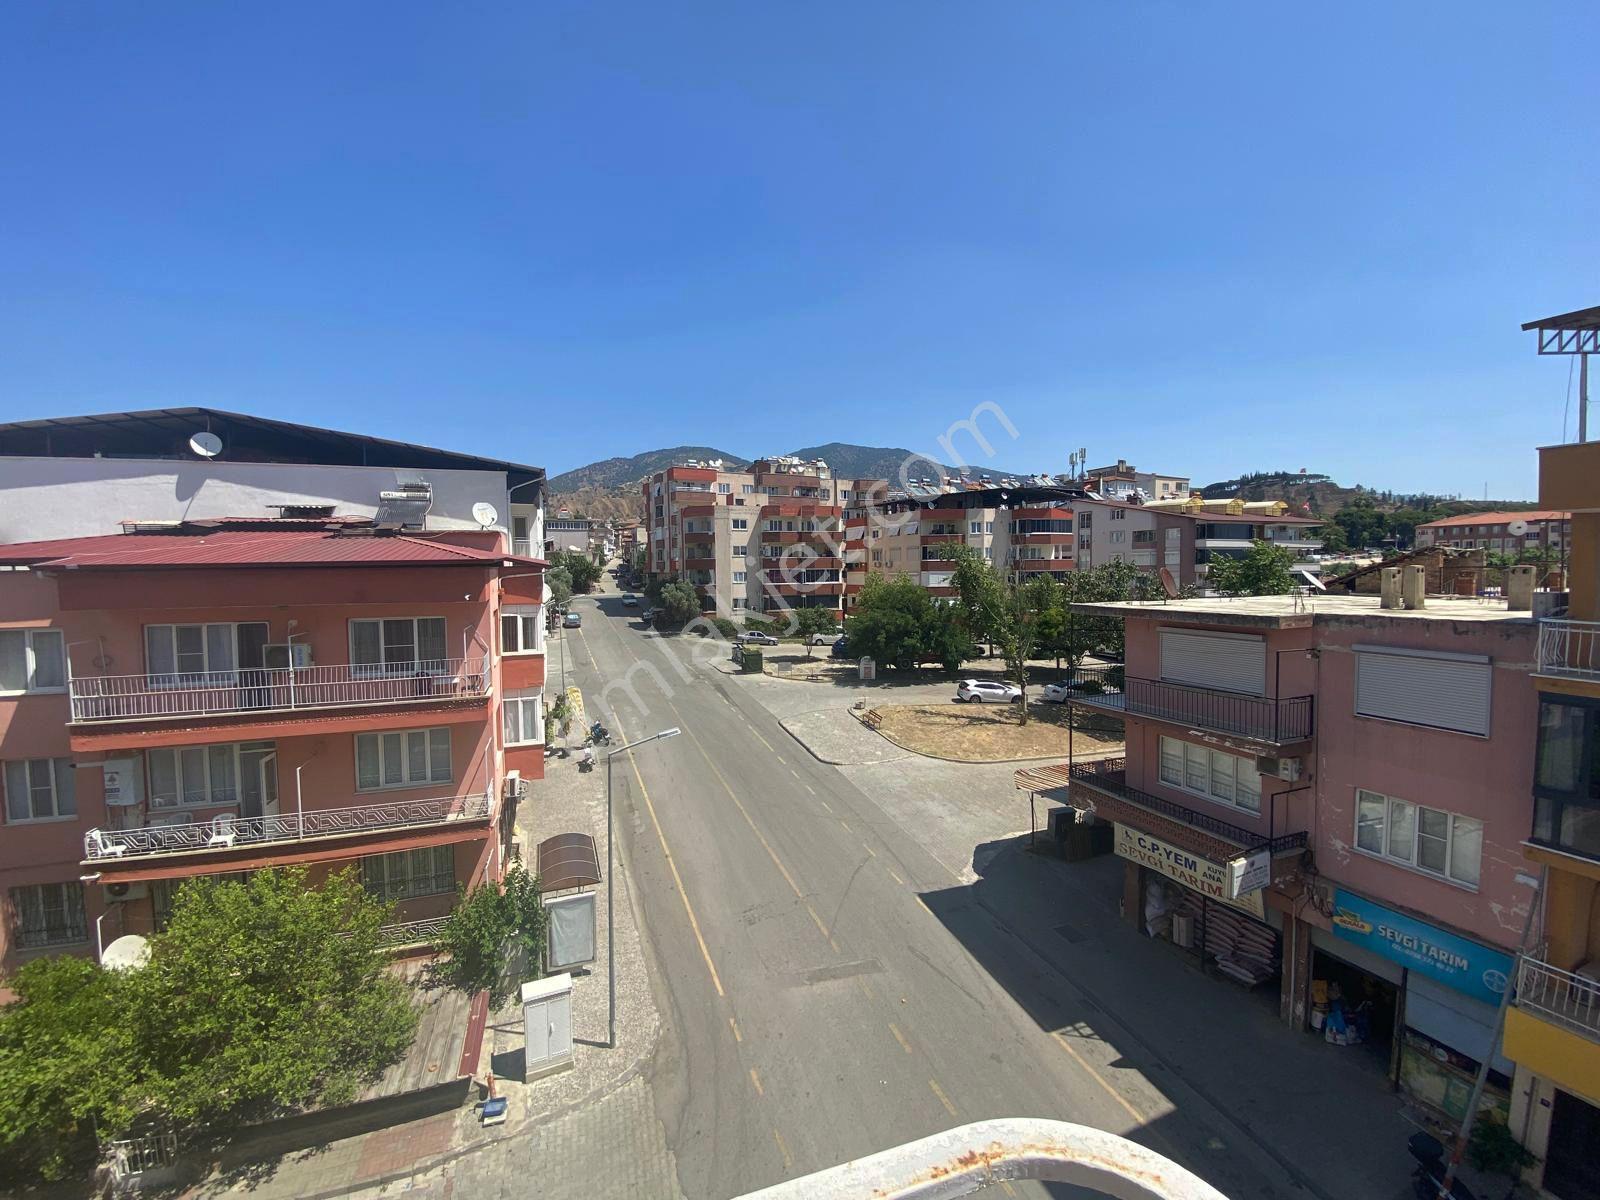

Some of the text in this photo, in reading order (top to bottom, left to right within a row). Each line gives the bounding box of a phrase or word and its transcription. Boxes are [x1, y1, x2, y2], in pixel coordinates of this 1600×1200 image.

[1119, 842, 1164, 870] SEVGİ
[1168, 864, 1223, 897] TARIM
[1378, 925, 1419, 951] SEVGİ
[1421, 942, 1469, 971] TARIM
